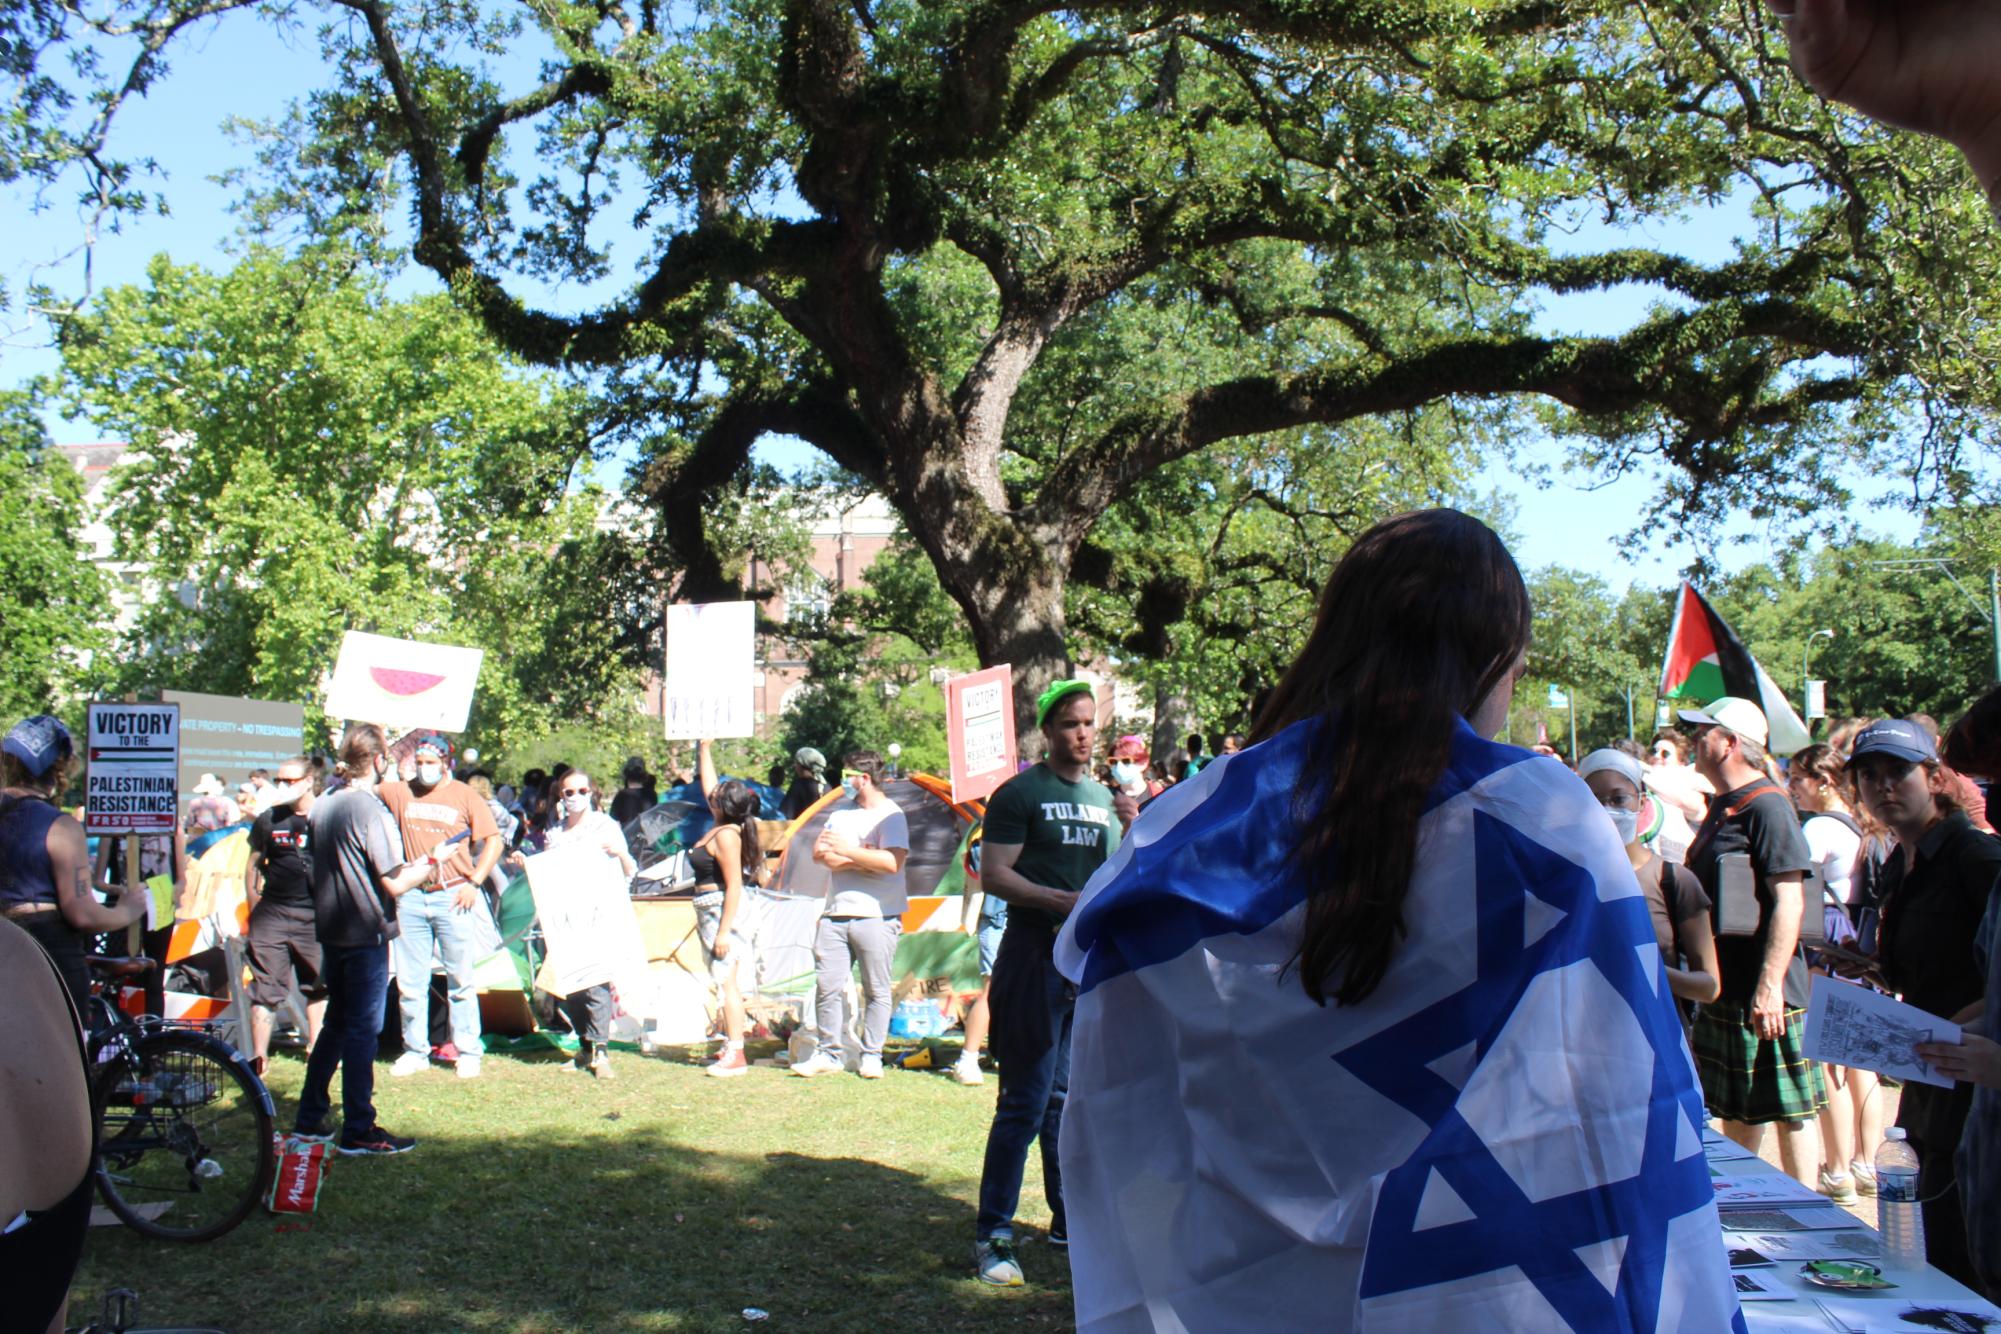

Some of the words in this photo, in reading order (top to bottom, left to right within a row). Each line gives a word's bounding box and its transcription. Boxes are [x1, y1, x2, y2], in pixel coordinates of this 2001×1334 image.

[96, 712, 172, 734] VICTORY
[198, 719, 237, 733] PROPERTY
[242, 723, 254, 735] NO
[255, 724, 302, 738] TRESPASSING
[119, 735, 130, 746] TO
[133, 735, 150, 746] THE
[90, 776, 175, 793] PALESTINIAN
[89, 795, 174, 812] RESISTANCE
[1041, 802, 1110, 827] TULANE
[1061, 824, 1100, 847] LAW
